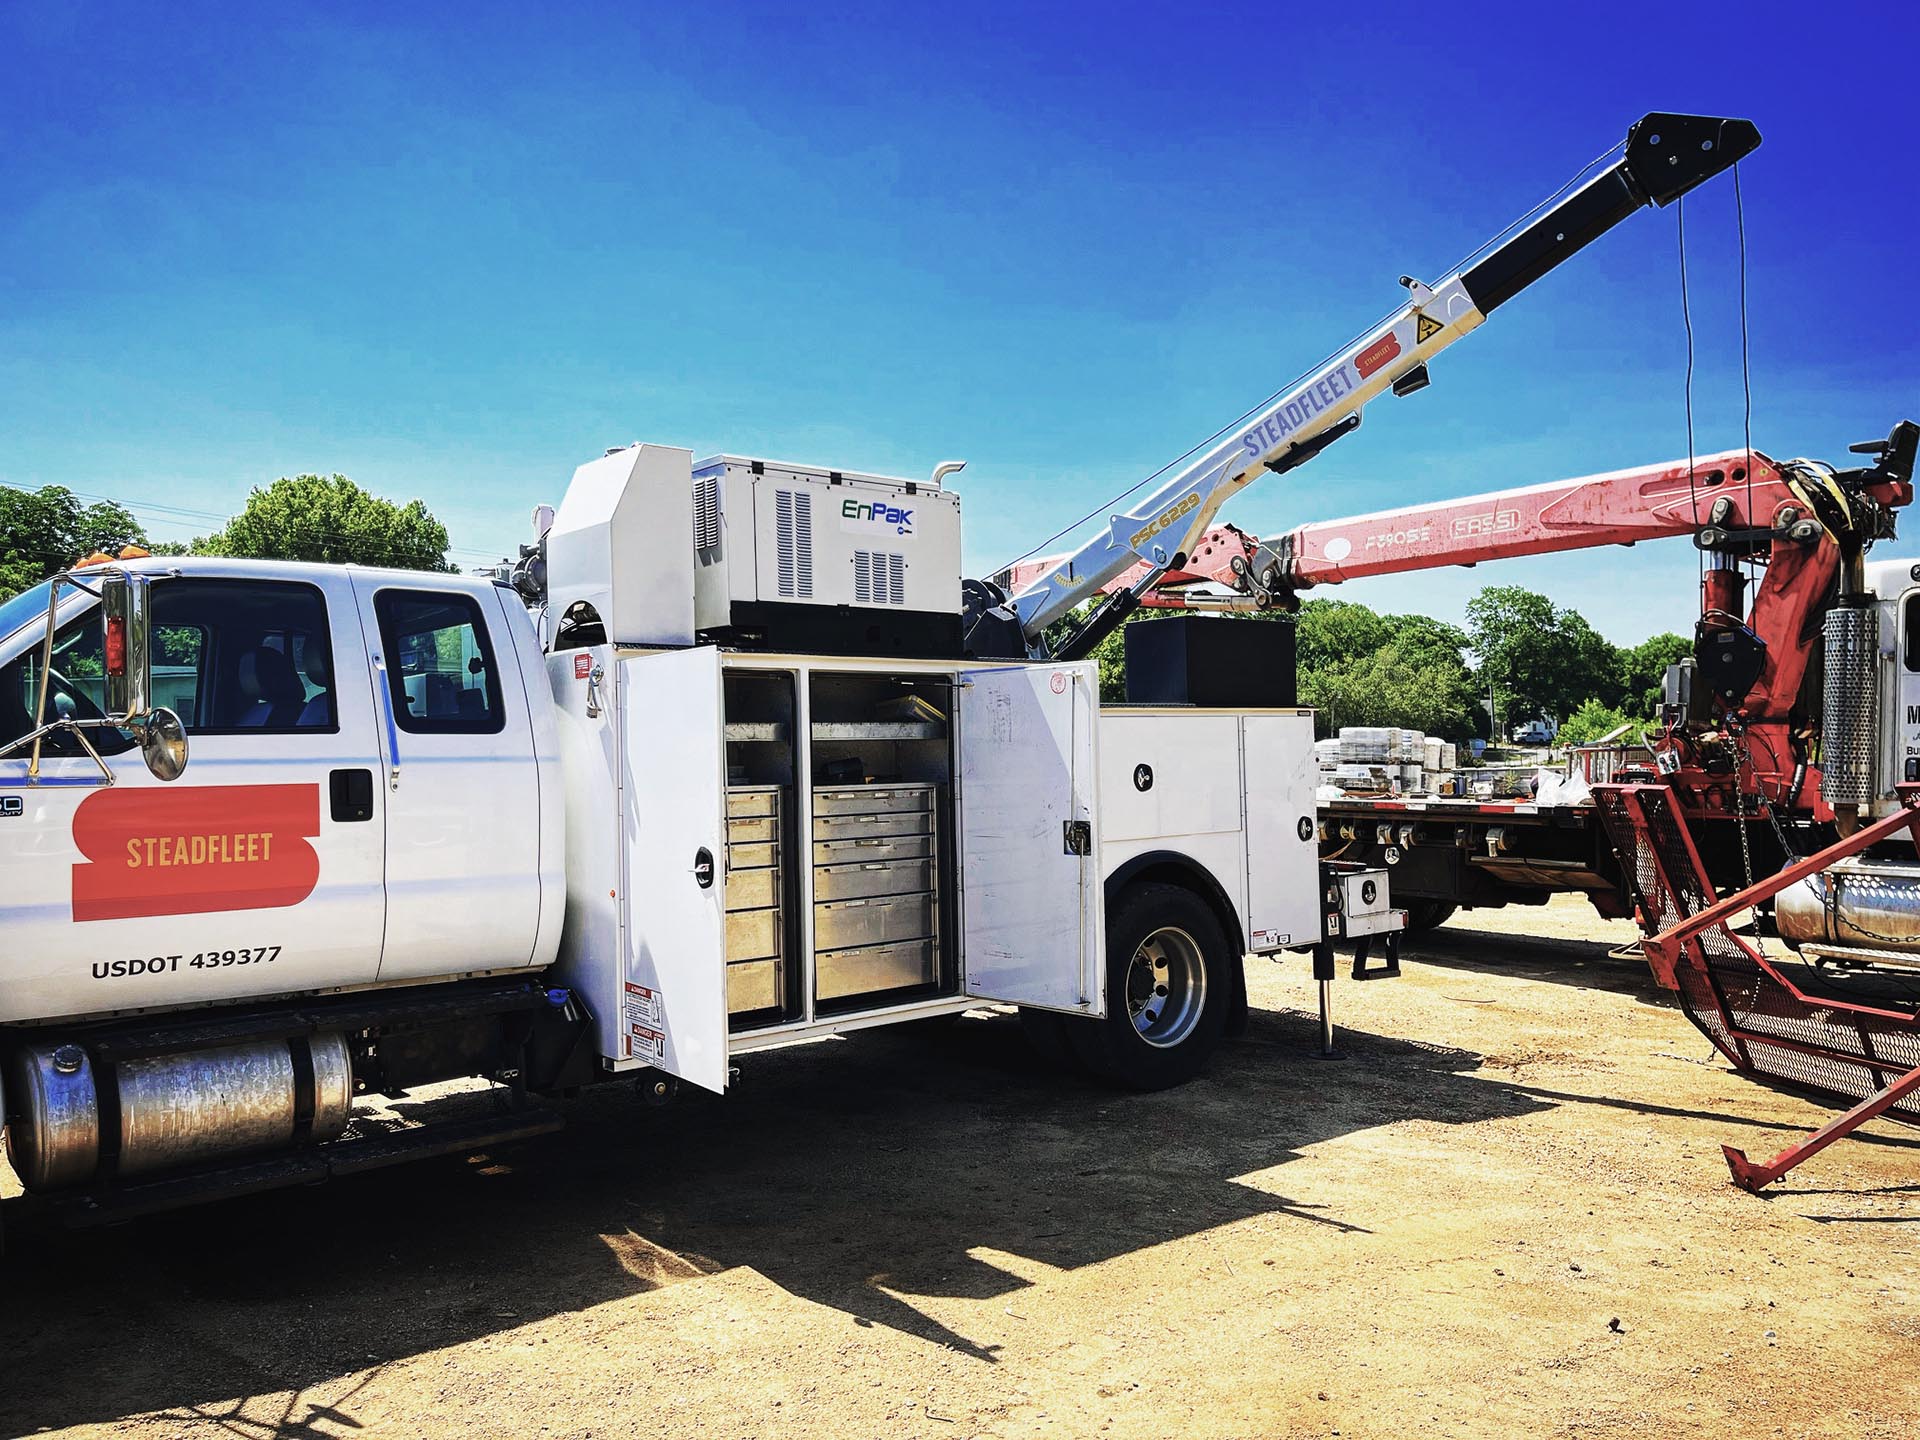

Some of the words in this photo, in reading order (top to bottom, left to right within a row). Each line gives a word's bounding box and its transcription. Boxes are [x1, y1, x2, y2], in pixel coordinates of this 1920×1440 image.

[1243, 365, 1353, 457] STEADFLEET
[842, 499, 914, 525] EnPak
[1130, 521, 1160, 549] PSC
[1159, 493, 1200, 528] 6229
[1454, 511, 1516, 536] FASSI
[127, 832, 273, 868] STEADFLEET
[92, 955, 183, 979] USDOT
[189, 946, 282, 969] 439377
